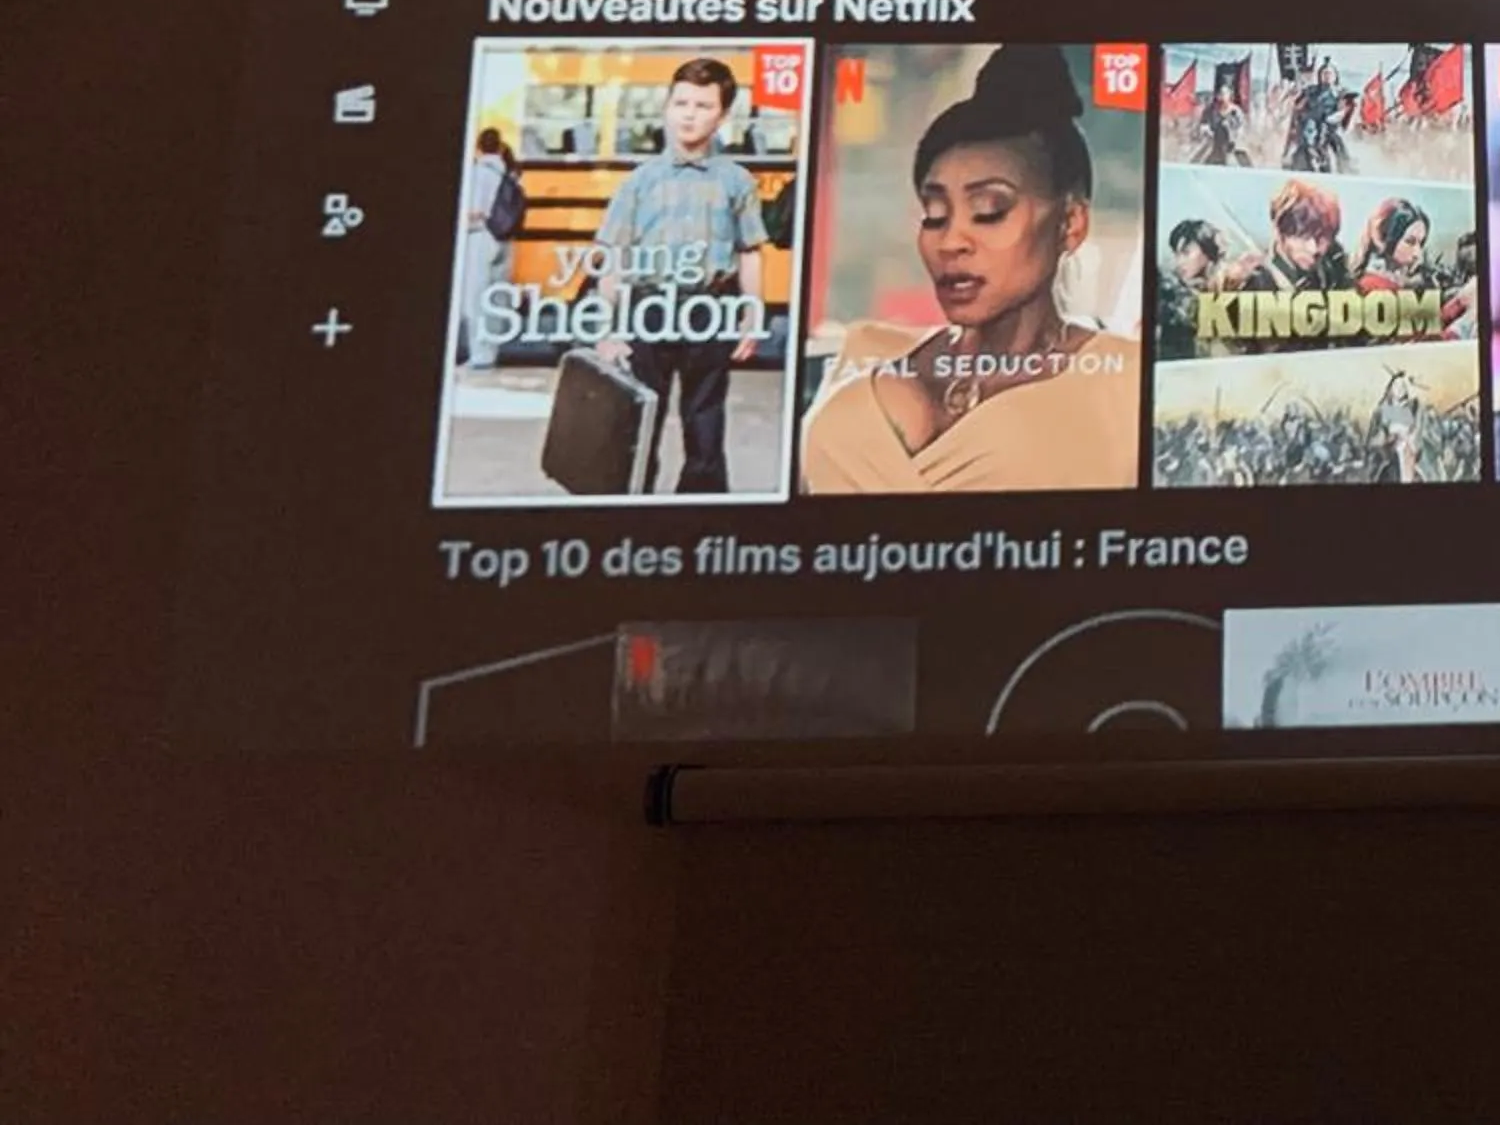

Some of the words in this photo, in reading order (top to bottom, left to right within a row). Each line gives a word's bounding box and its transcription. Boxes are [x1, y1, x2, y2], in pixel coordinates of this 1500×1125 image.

[761, 54, 802, 72] TOP
[1101, 53, 1140, 71] TOP
[763, 70, 799, 95] 10
[835, 58, 865, 105] N
[1103, 68, 1139, 94] 10
[549, 241, 707, 285] young
[476, 282, 772, 343] Sheldon
[1199, 288, 1442, 339] KINGDOM
[822, 355, 918, 379] FATAL
[934, 352, 1125, 378] SEDUCTION
[440, 540, 529, 587] Top
[540, 539, 590, 578] 10
[603, 538, 683, 577] des
[695, 535, 801, 574] films
[812, 531, 1064, 582] aujourd'hui
[1098, 530, 1250, 568] France
